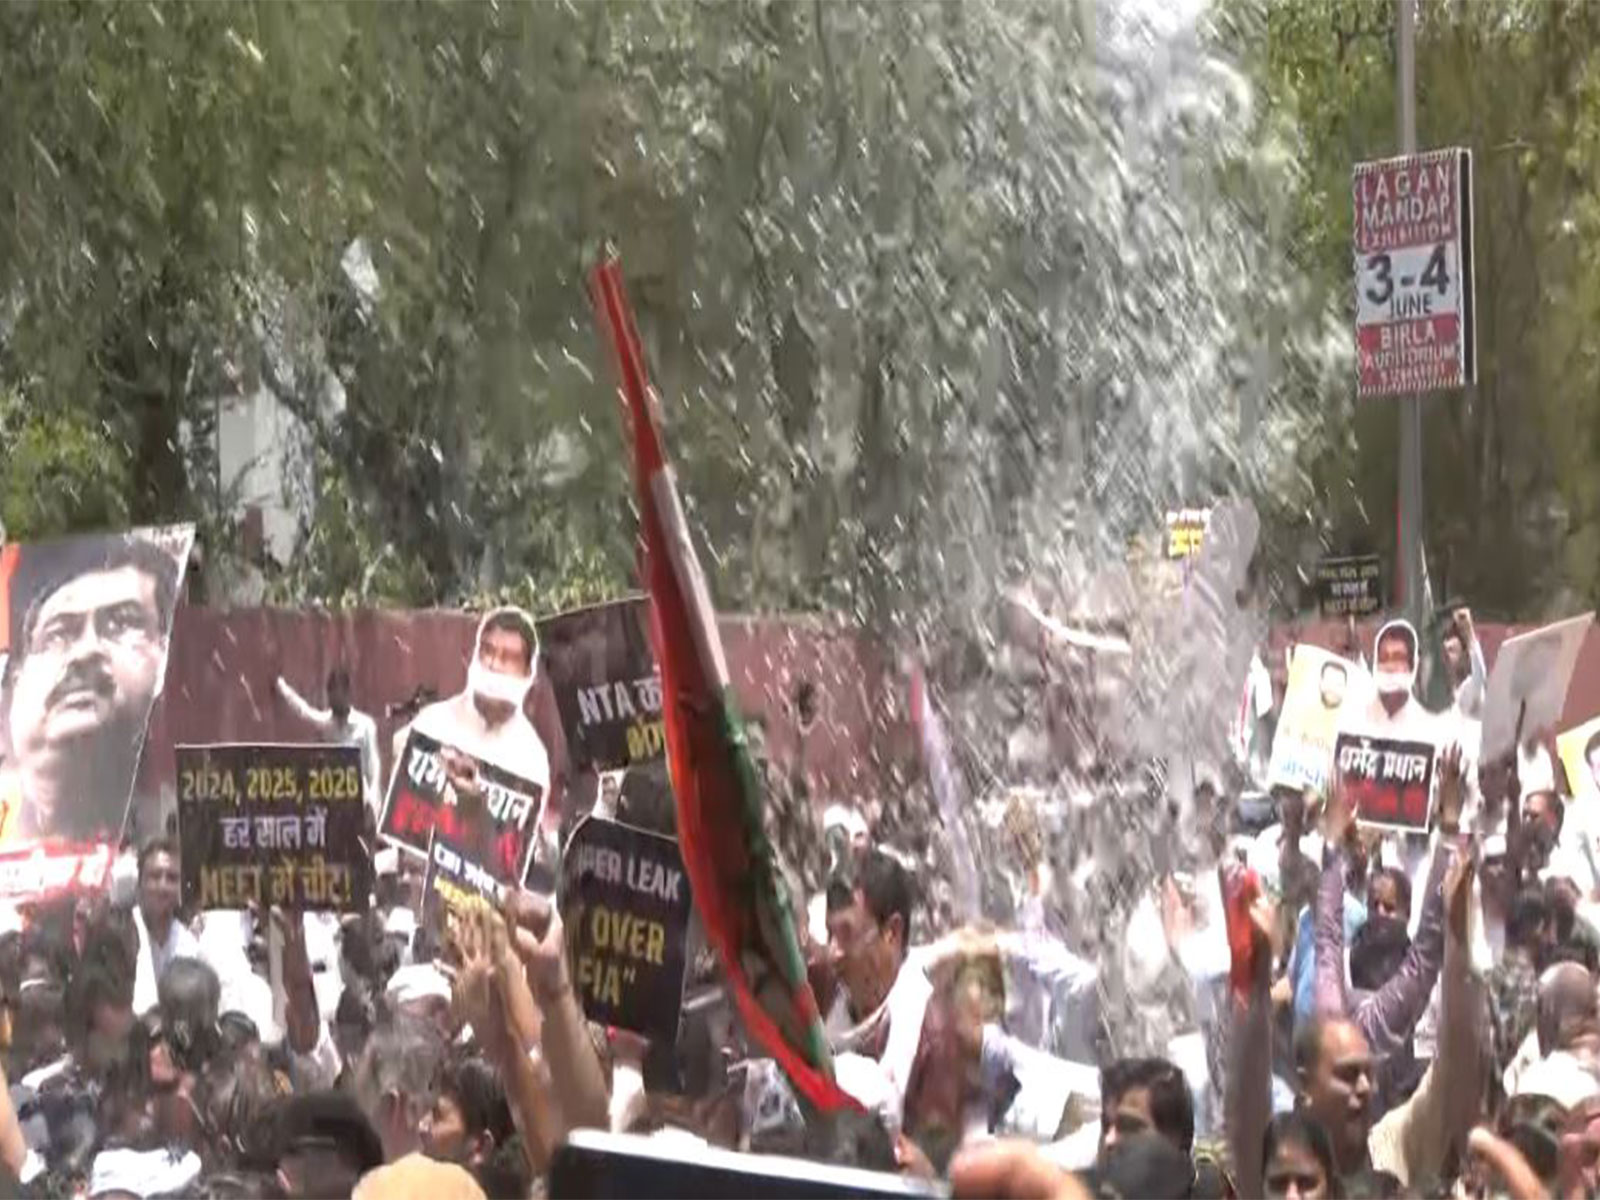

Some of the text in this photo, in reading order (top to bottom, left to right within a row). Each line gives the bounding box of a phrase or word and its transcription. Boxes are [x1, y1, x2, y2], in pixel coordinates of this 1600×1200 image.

[1361, 164, 1450, 206] LAGAN
[1362, 193, 1451, 230] MANDAP
[1366, 242, 1450, 305] 3-4
[1391, 292, 1433, 318] JUNE
[1380, 320, 1436, 350] BIRLA
[577, 680, 637, 727] NTA
[246, 766, 304, 805] 2025,
[308, 765, 359, 799] 2026
[219, 806, 329, 850] हर साल में
[201, 864, 262, 908] NEET
[626, 851, 683, 902] LEAK
[591, 903, 666, 966] OVER
